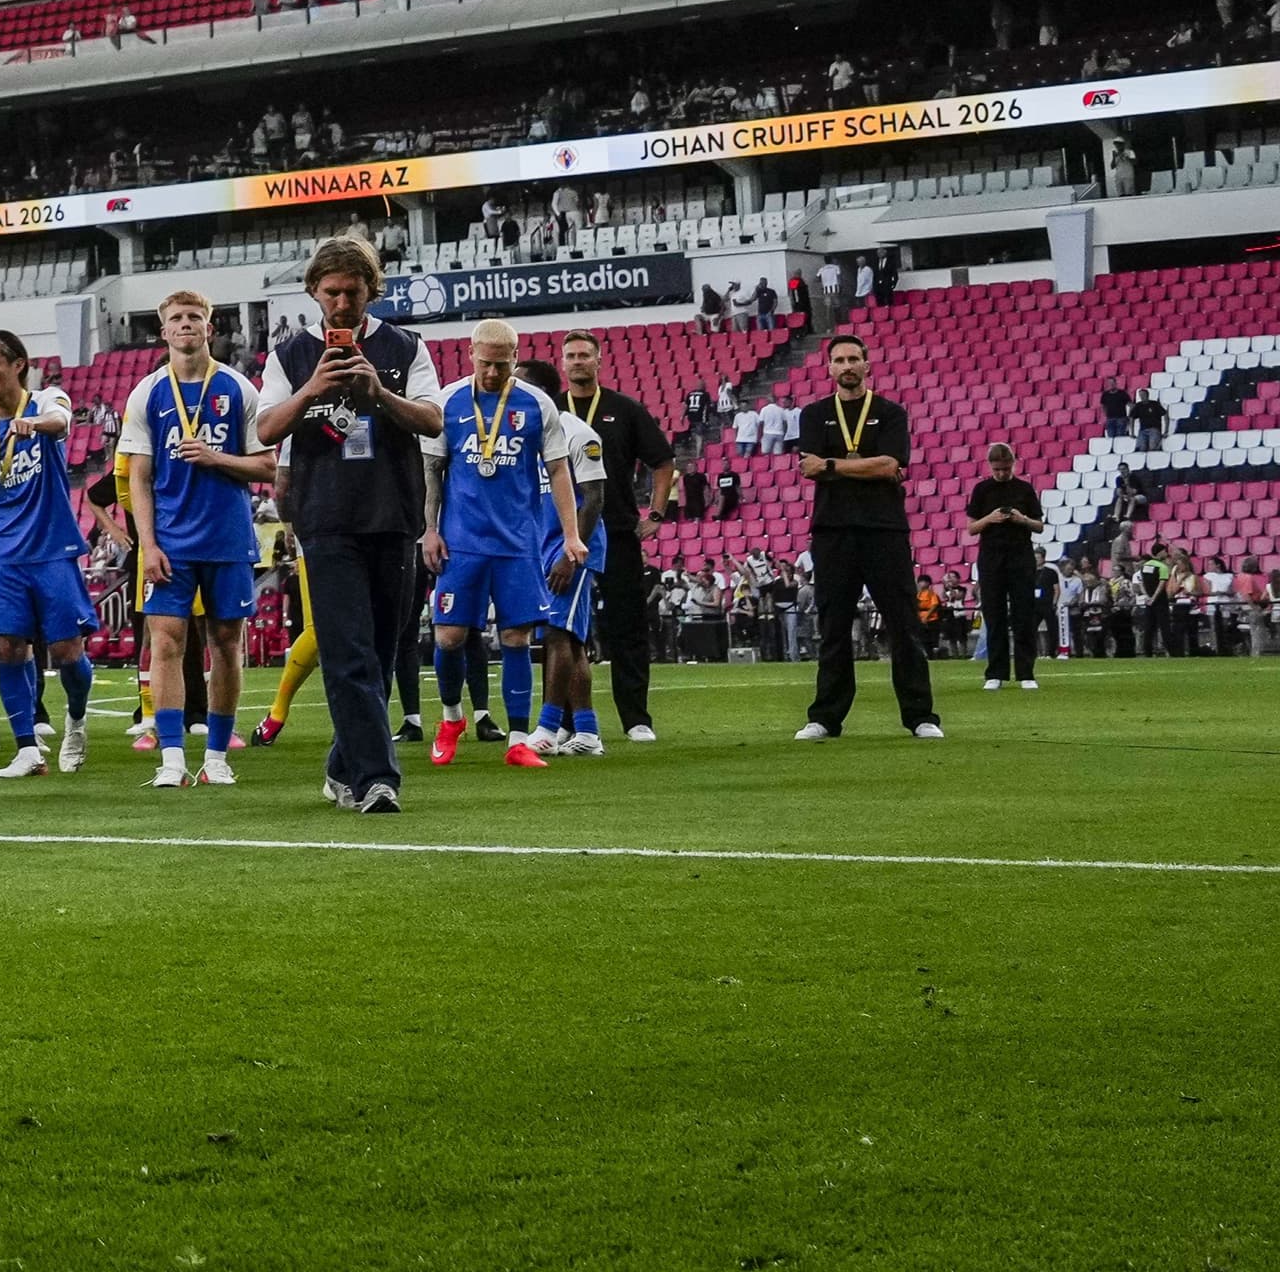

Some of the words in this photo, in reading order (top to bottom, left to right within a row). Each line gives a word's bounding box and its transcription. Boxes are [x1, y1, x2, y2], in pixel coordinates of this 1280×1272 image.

[640, 132, 724, 161] JOHAN
[733, 119, 836, 149] CRUIJFF
[844, 107, 950, 137] SCHAAL
[958, 98, 1023, 126] 2026
[264, 170, 372, 199] WINNAAR
[379, 166, 409, 188] AZ
[20, 203, 65, 225] 2026
[453, 271, 541, 307] philips
[547, 263, 649, 295] stadion
[166, 423, 230, 449] AAS
[461, 433, 524, 456] AAS
